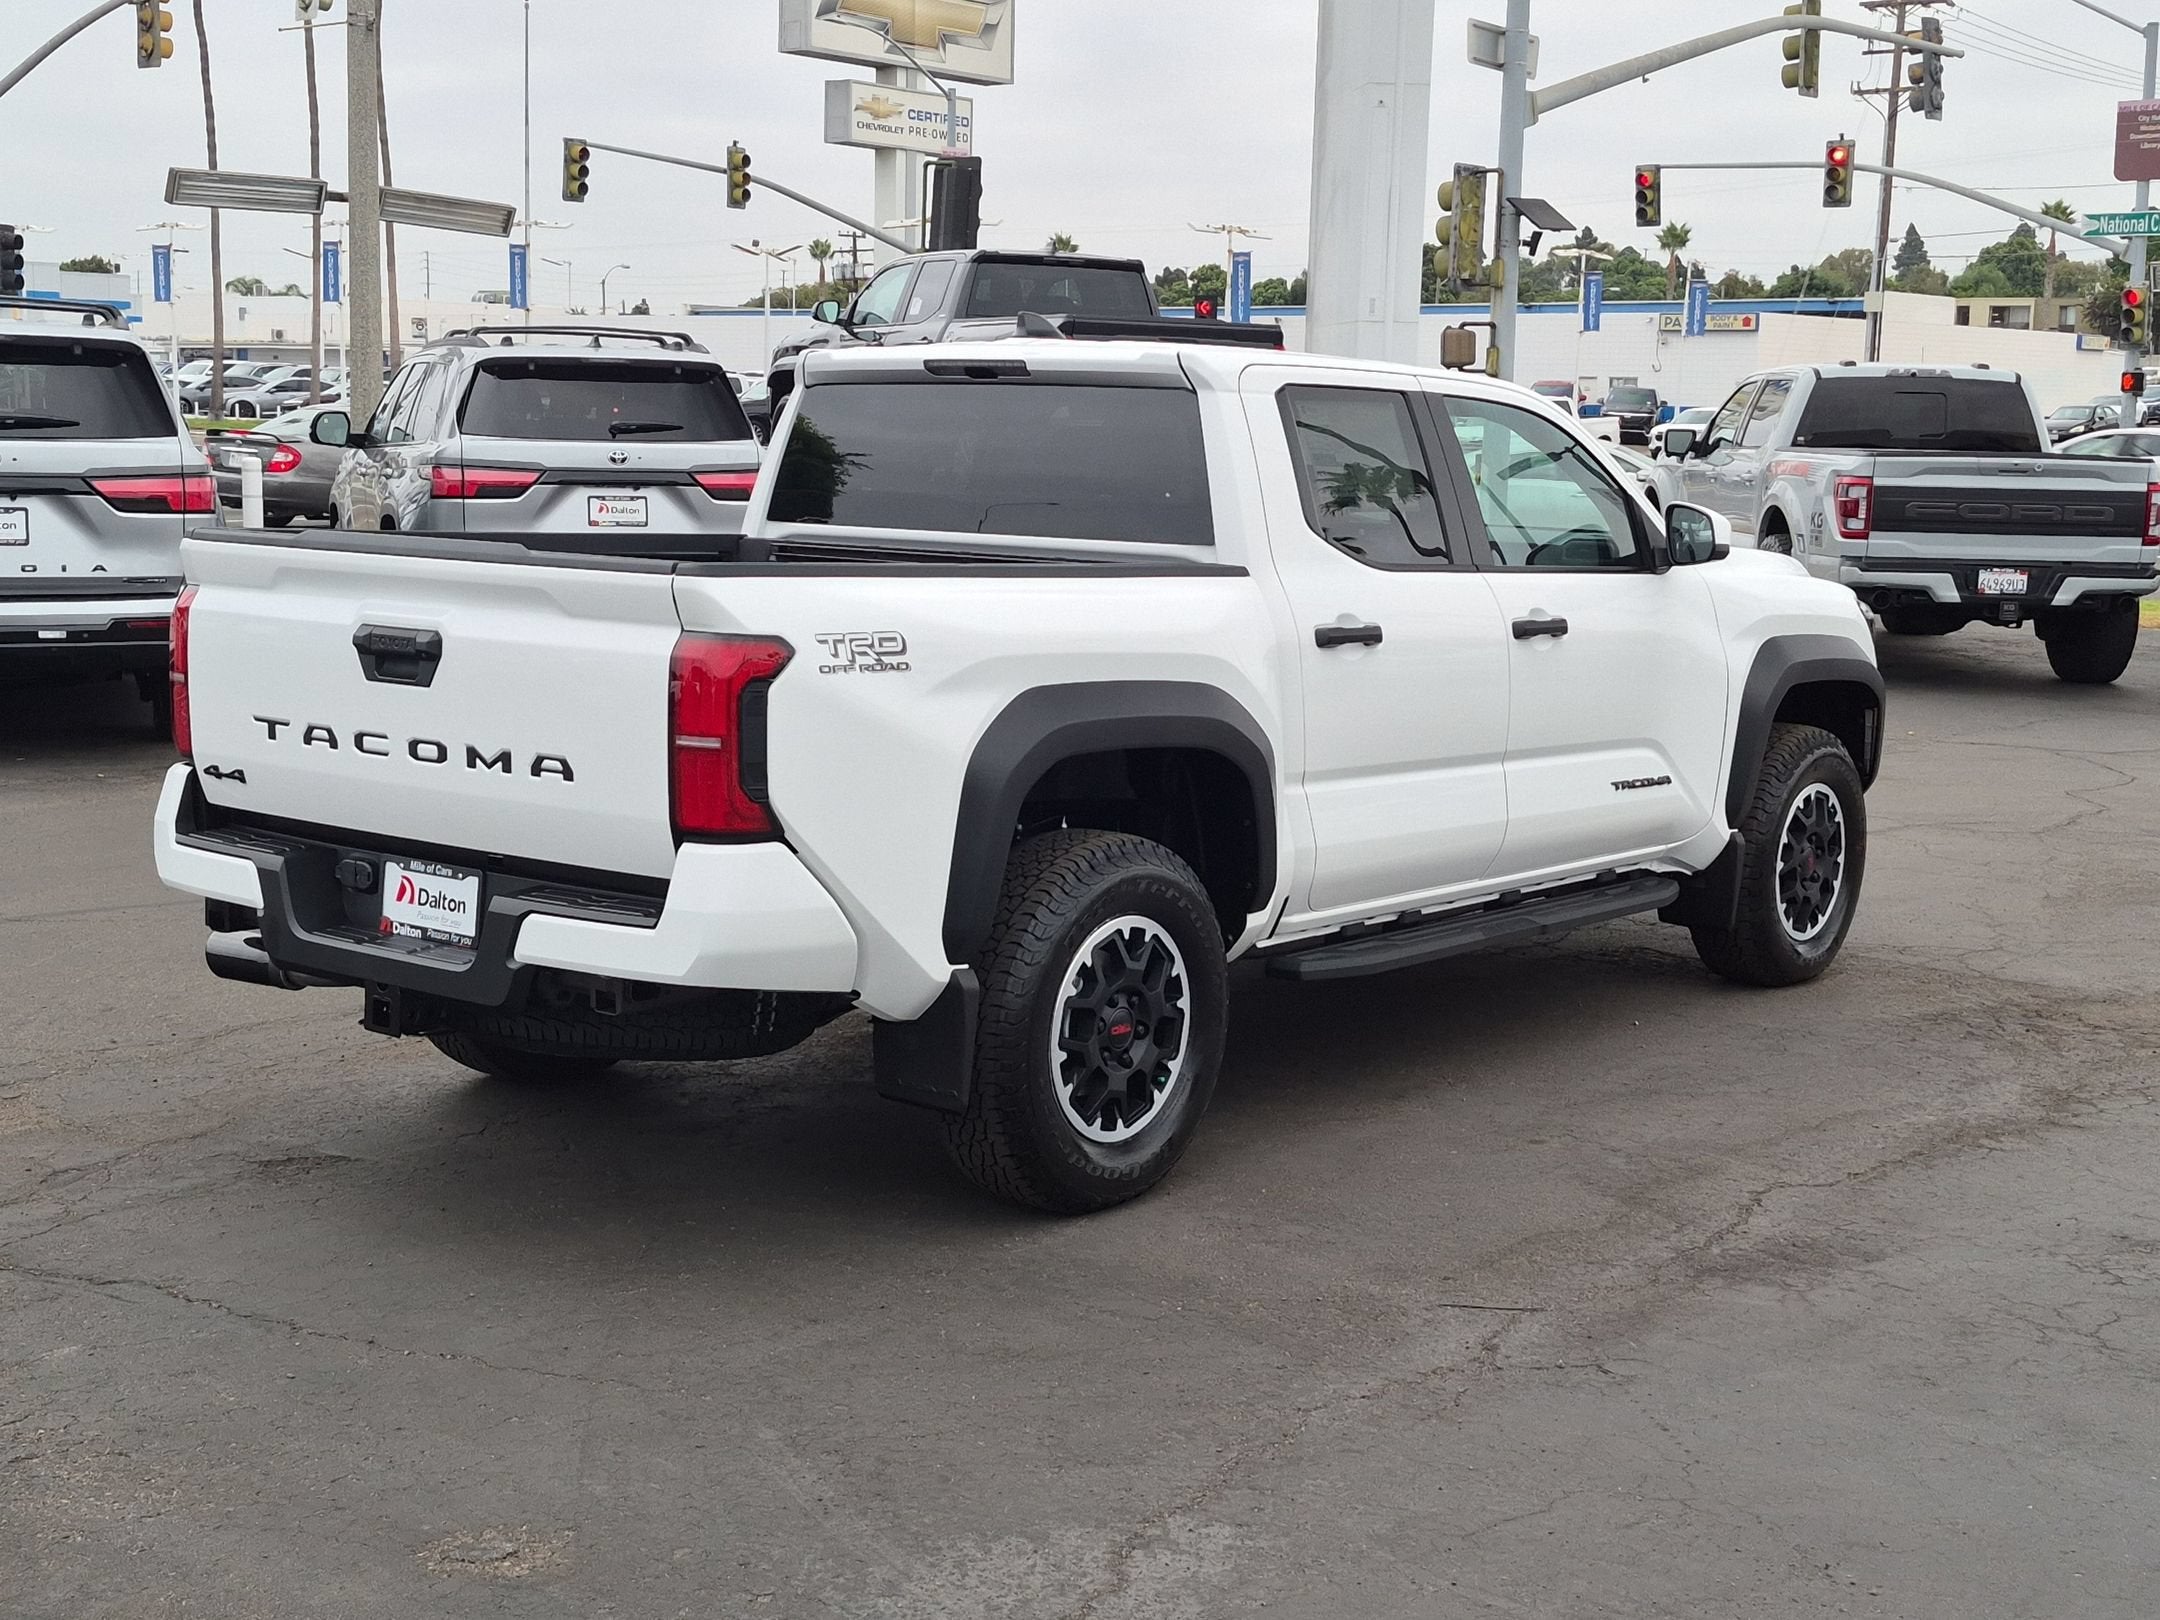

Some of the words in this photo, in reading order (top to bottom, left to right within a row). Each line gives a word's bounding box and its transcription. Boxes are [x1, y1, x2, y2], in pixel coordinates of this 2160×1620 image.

[907, 108, 970, 128] CERTIFED
[856, 120, 905, 135] CHEVROLET
[908, 125, 969, 143] PRE-OWED
[2099, 214, 2149, 234] National
[610, 506, 640, 514] Dalton
[1904, 501, 2116, 522] FORD
[814, 630, 908, 664] TRD
[819, 664, 857, 674] OFF
[859, 661, 912, 674] ROAD
[251, 714, 576, 783] TACOMA
[1610, 775, 1673, 792] TACOMA
[409, 860, 426, 872] Mile
[426, 864, 435, 873] of
[435, 865, 453, 877] Cars
[417, 887, 467, 915] Dalton
[392, 921, 422, 939] Dalton
[426, 928, 450, 941] Passion
[450, 932, 460, 943] for
[459, 936, 473, 946] you
